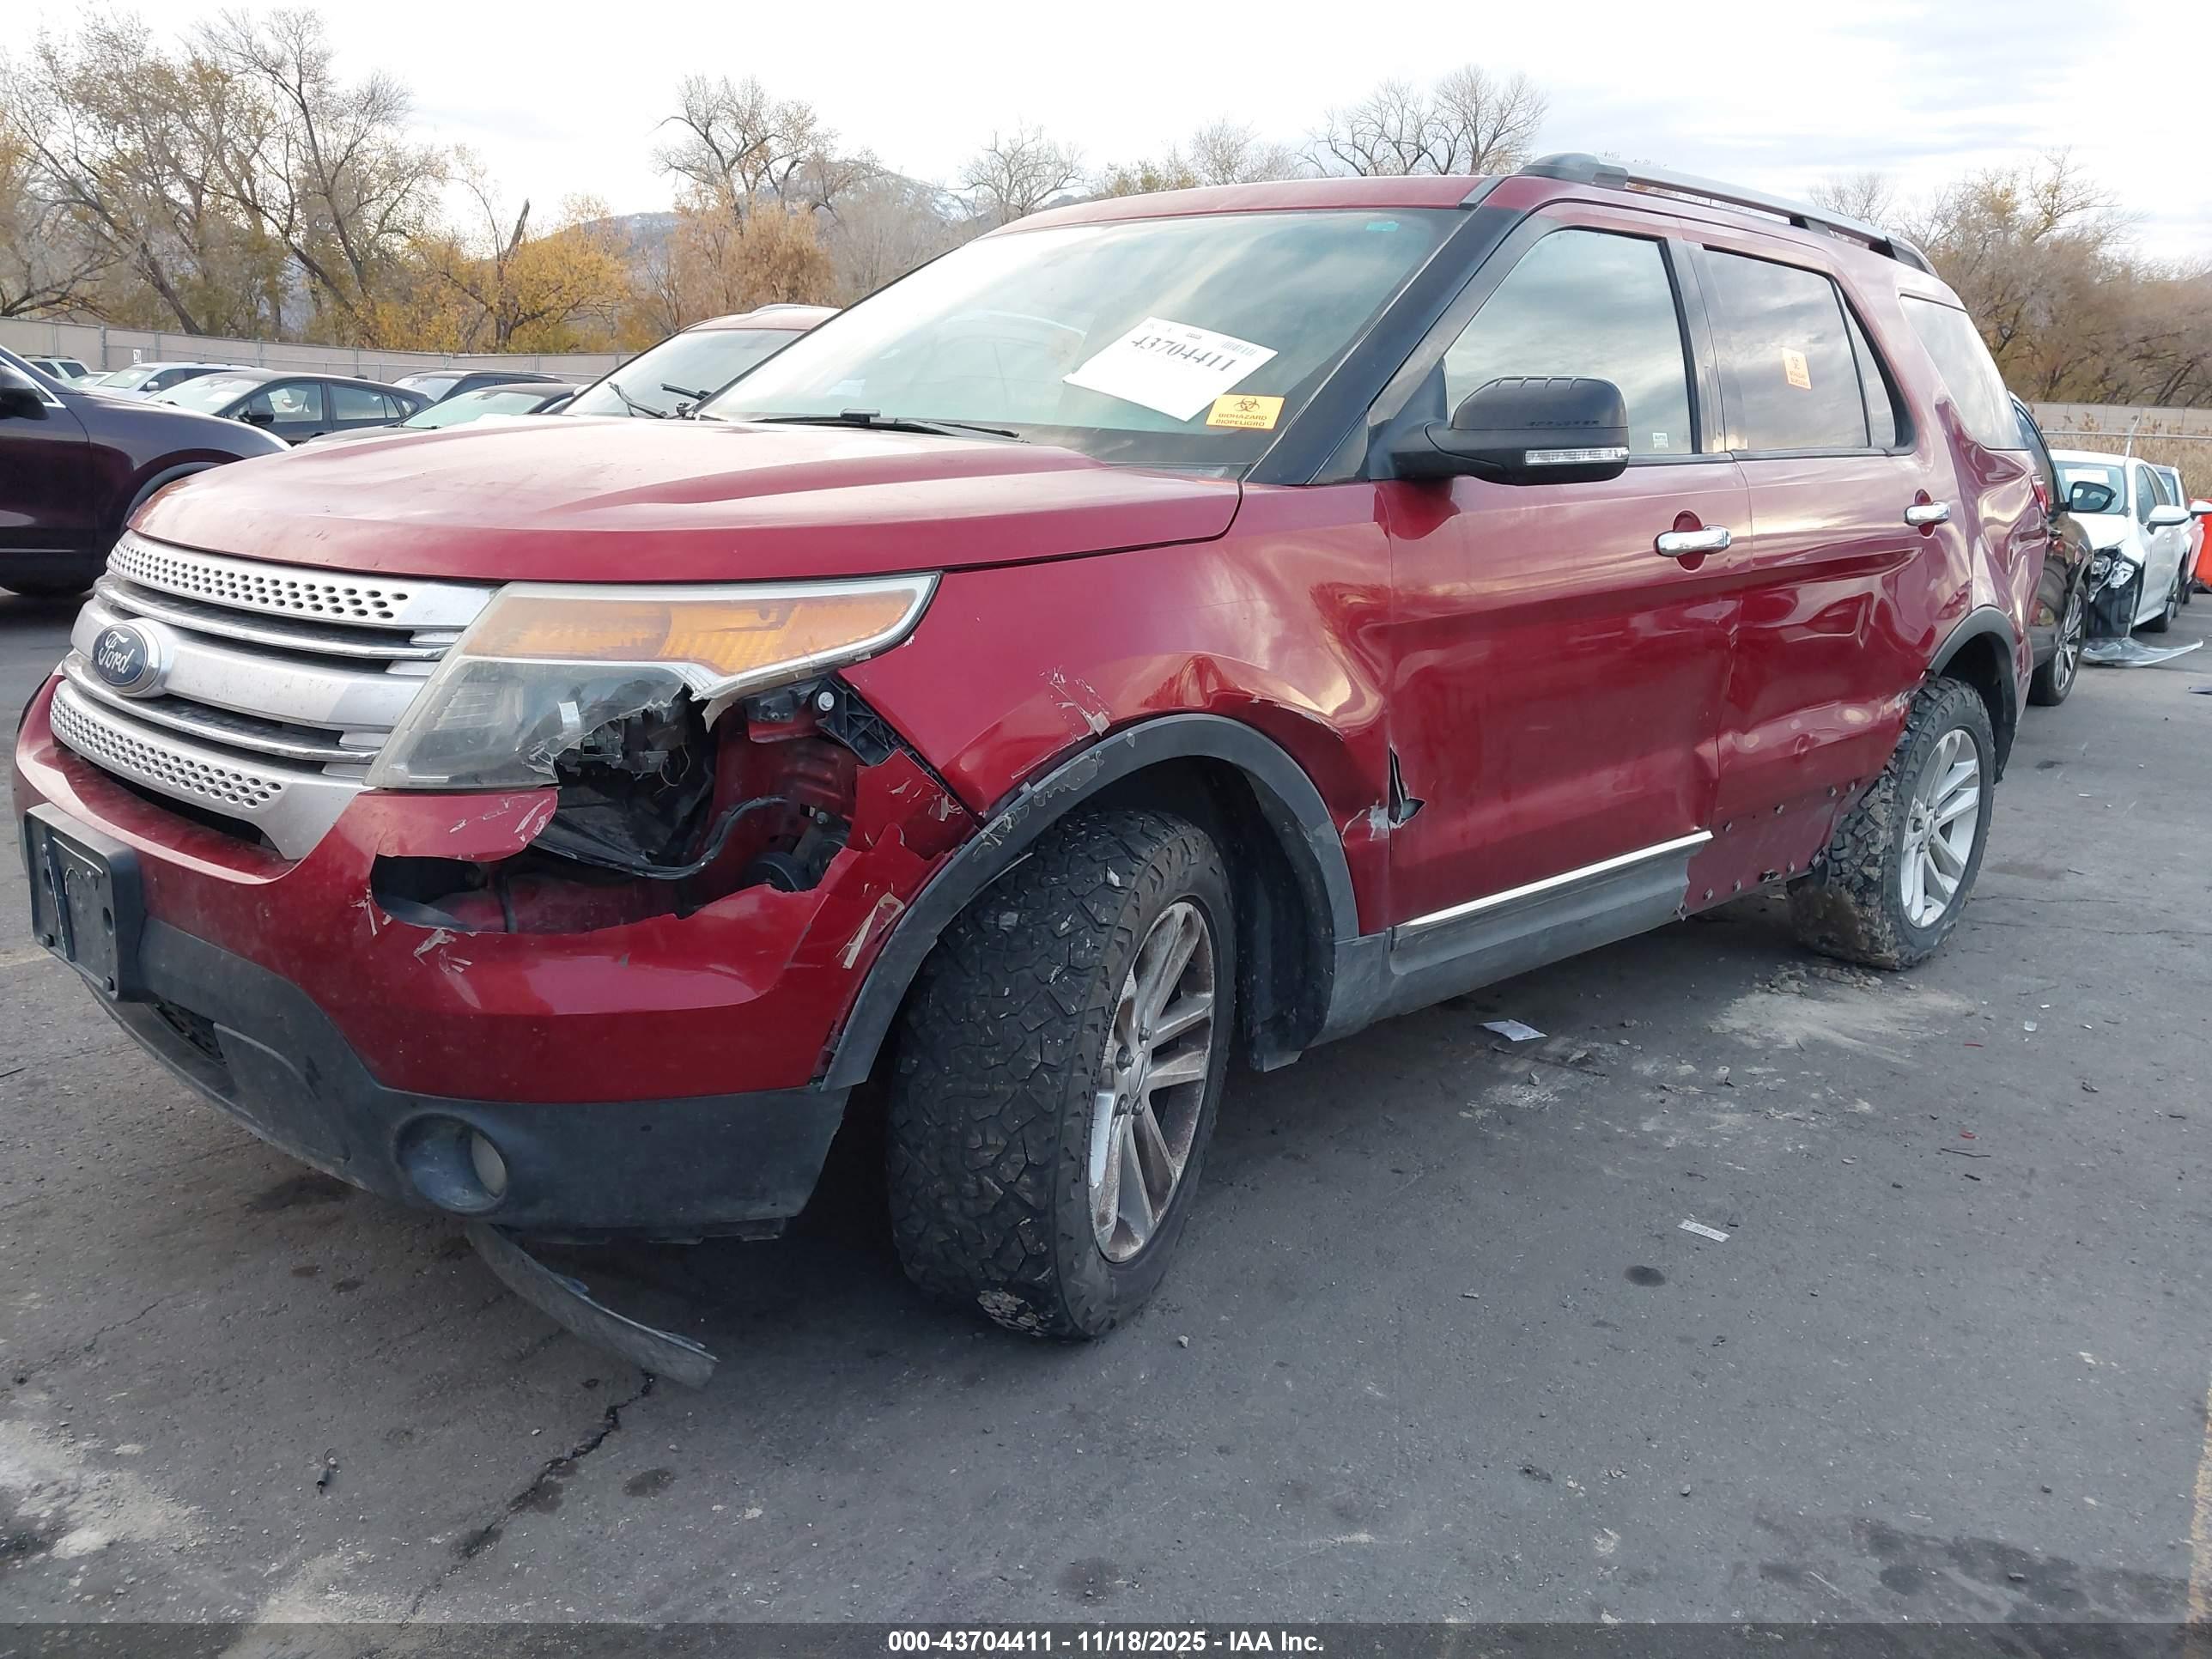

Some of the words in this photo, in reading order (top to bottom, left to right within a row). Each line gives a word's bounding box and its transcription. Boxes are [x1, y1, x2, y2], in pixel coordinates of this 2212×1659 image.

[1131, 335, 1237, 372] 43704411
[1215, 418, 1266, 427] BIOPELIGRO
[98, 630, 136, 674] Ford
